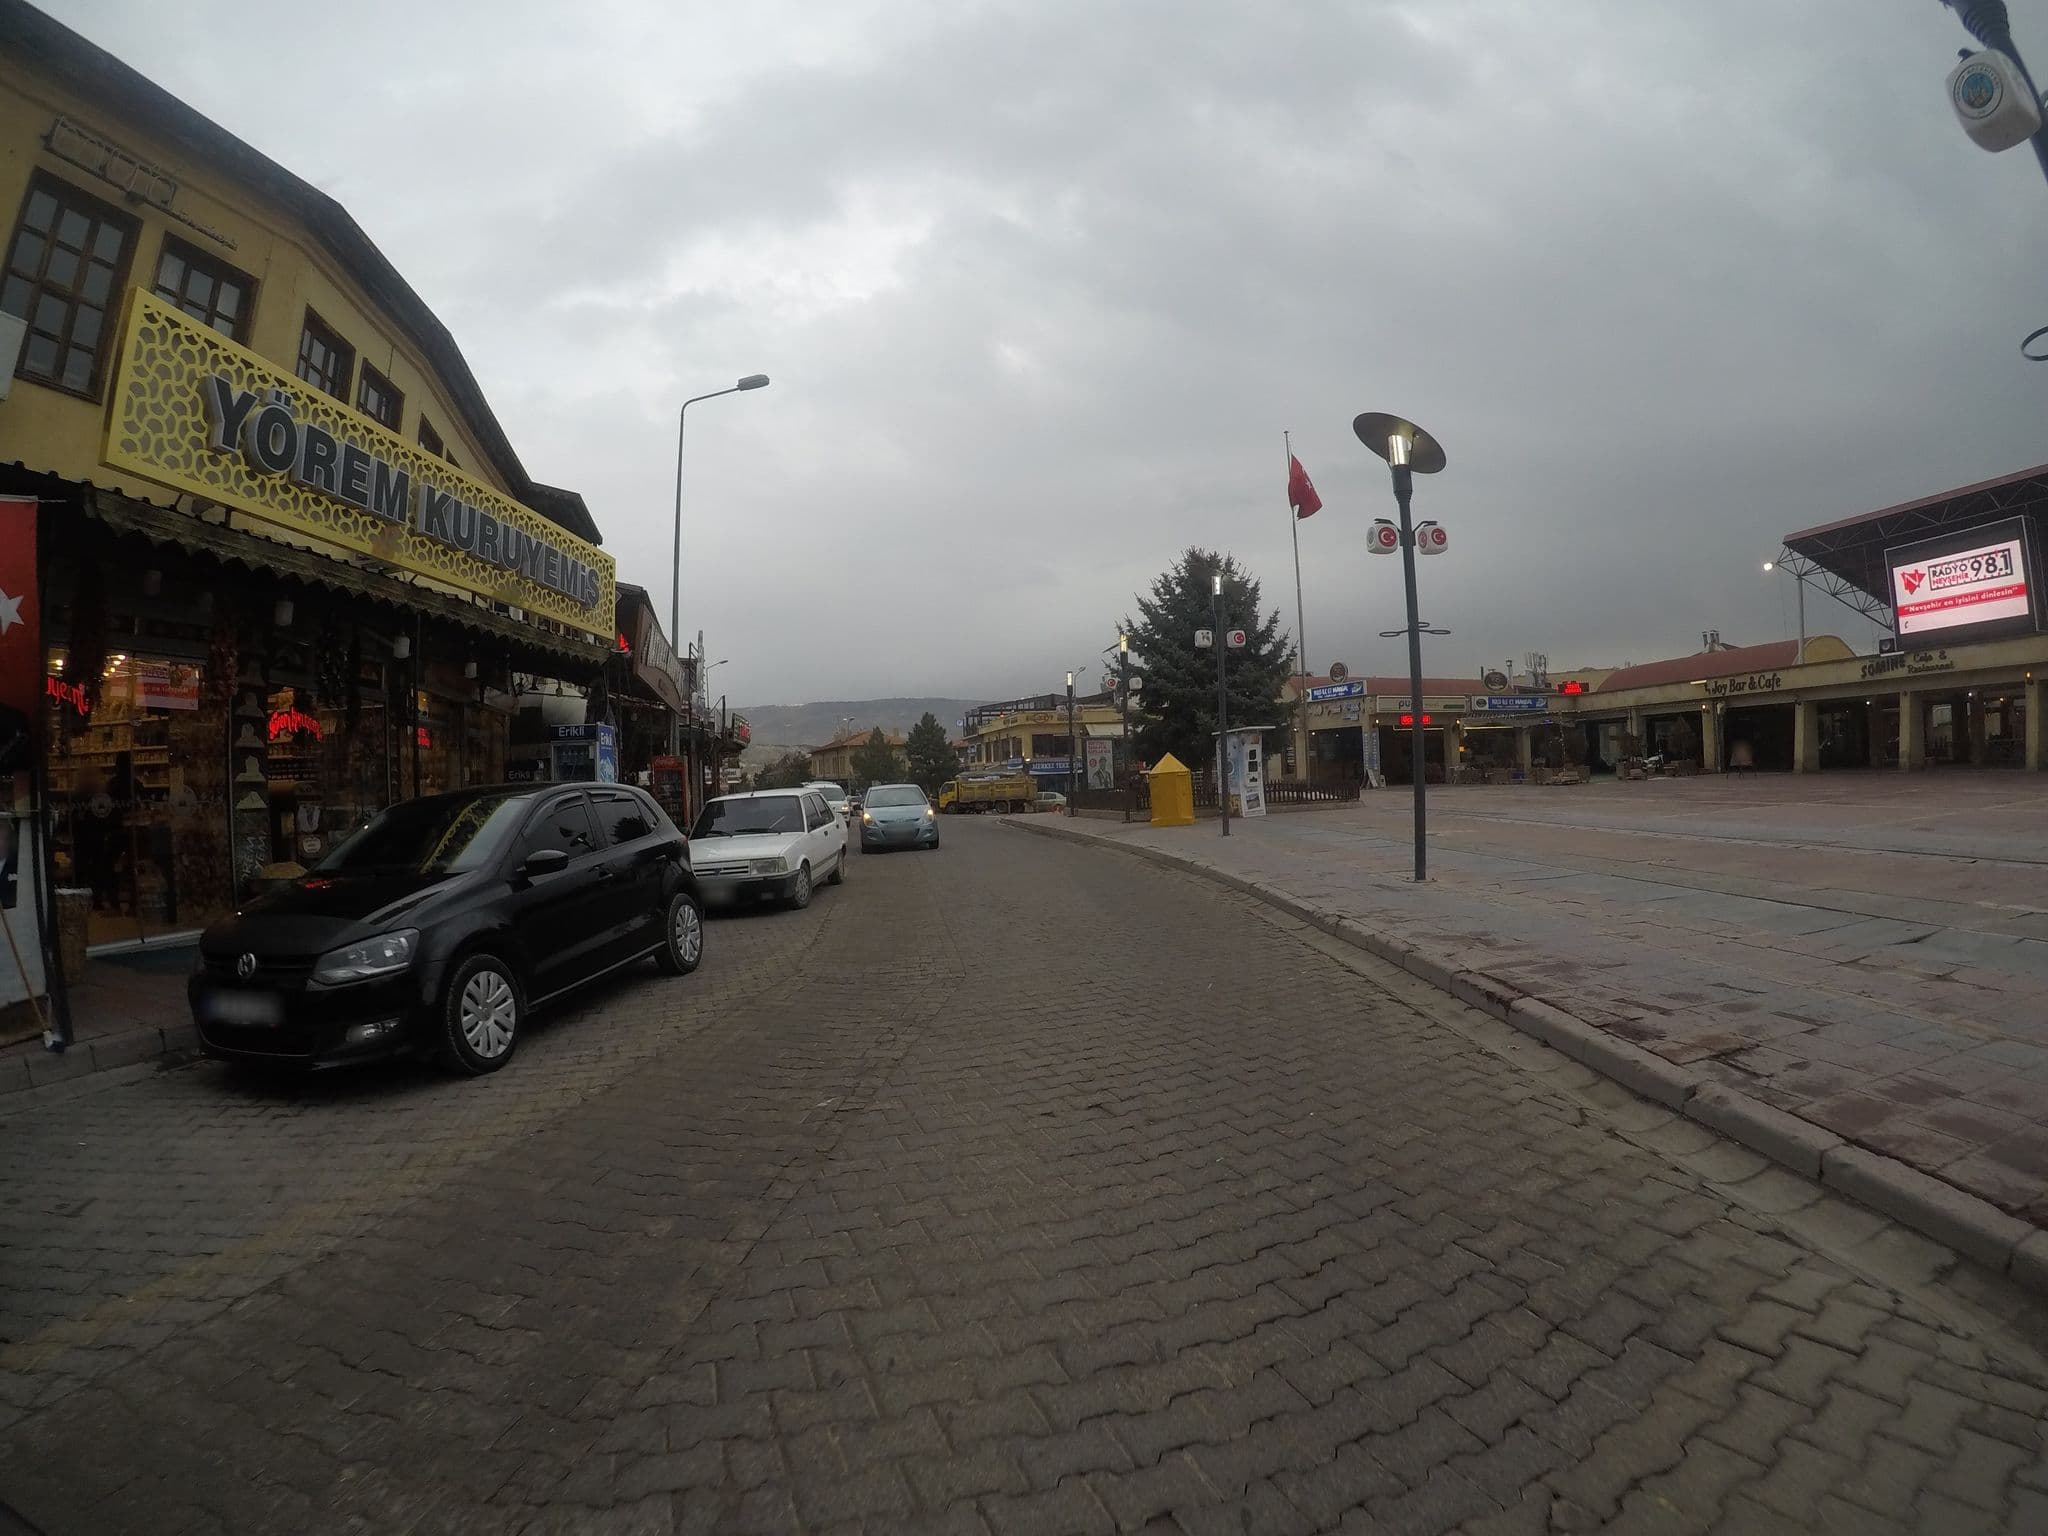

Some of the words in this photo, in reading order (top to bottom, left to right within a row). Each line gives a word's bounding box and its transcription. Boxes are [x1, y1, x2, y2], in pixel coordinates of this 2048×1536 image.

[203, 372, 411, 525] YÖREM
[1931, 563, 1968, 578] RADYO
[1970, 553, 2010, 578] 98.1
[1943, 599, 1954, 607] en
[1729, 678, 1747, 693] Bar
[1748, 675, 1757, 690] &
[558, 726, 585, 738] Erikli
